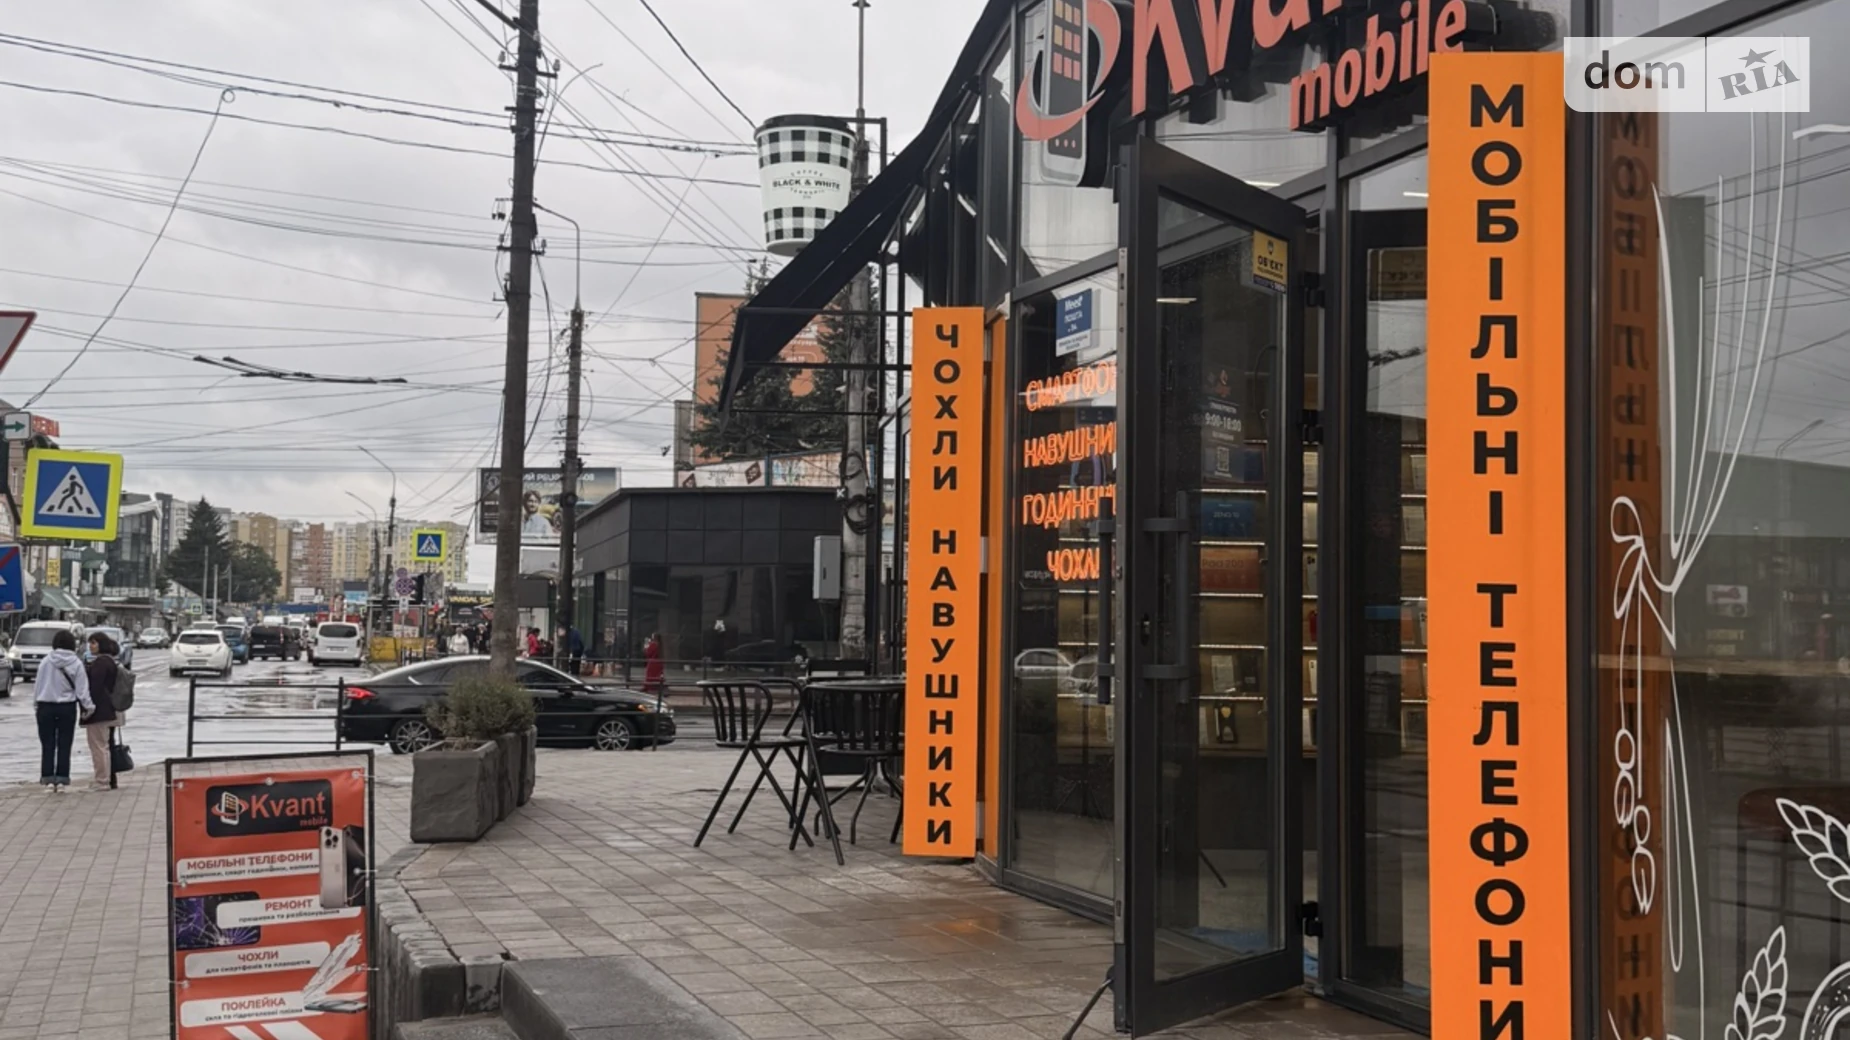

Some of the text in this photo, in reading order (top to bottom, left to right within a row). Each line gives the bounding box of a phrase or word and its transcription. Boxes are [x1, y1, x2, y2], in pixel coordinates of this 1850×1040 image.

[1290, 0, 1467, 131] mobile
[772, 179, 801, 188] BLACK
[814, 180, 840, 190] WHITE
[1024, 421, 1117, 468] НАВУШНИ
[1046, 547, 1100, 581] ЧОХЛ
[1470, 84, 1529, 1040] МОБІЛЬНІ ТЕЛЕФОНИ
[924, 324, 961, 845] ЧОХЛИ НАВУШНИКИ
[251, 791, 326, 819] Kvant
[300, 815, 328, 827] mobile
[187, 852, 313, 870] МОБІЛЬНІ ТЕЛЕФОНИ
[265, 899, 313, 912] РЕМОНТ
[237, 950, 279, 962] ЧОХЛИ
[221, 997, 286, 1012] ПОКЛЕЙКА
